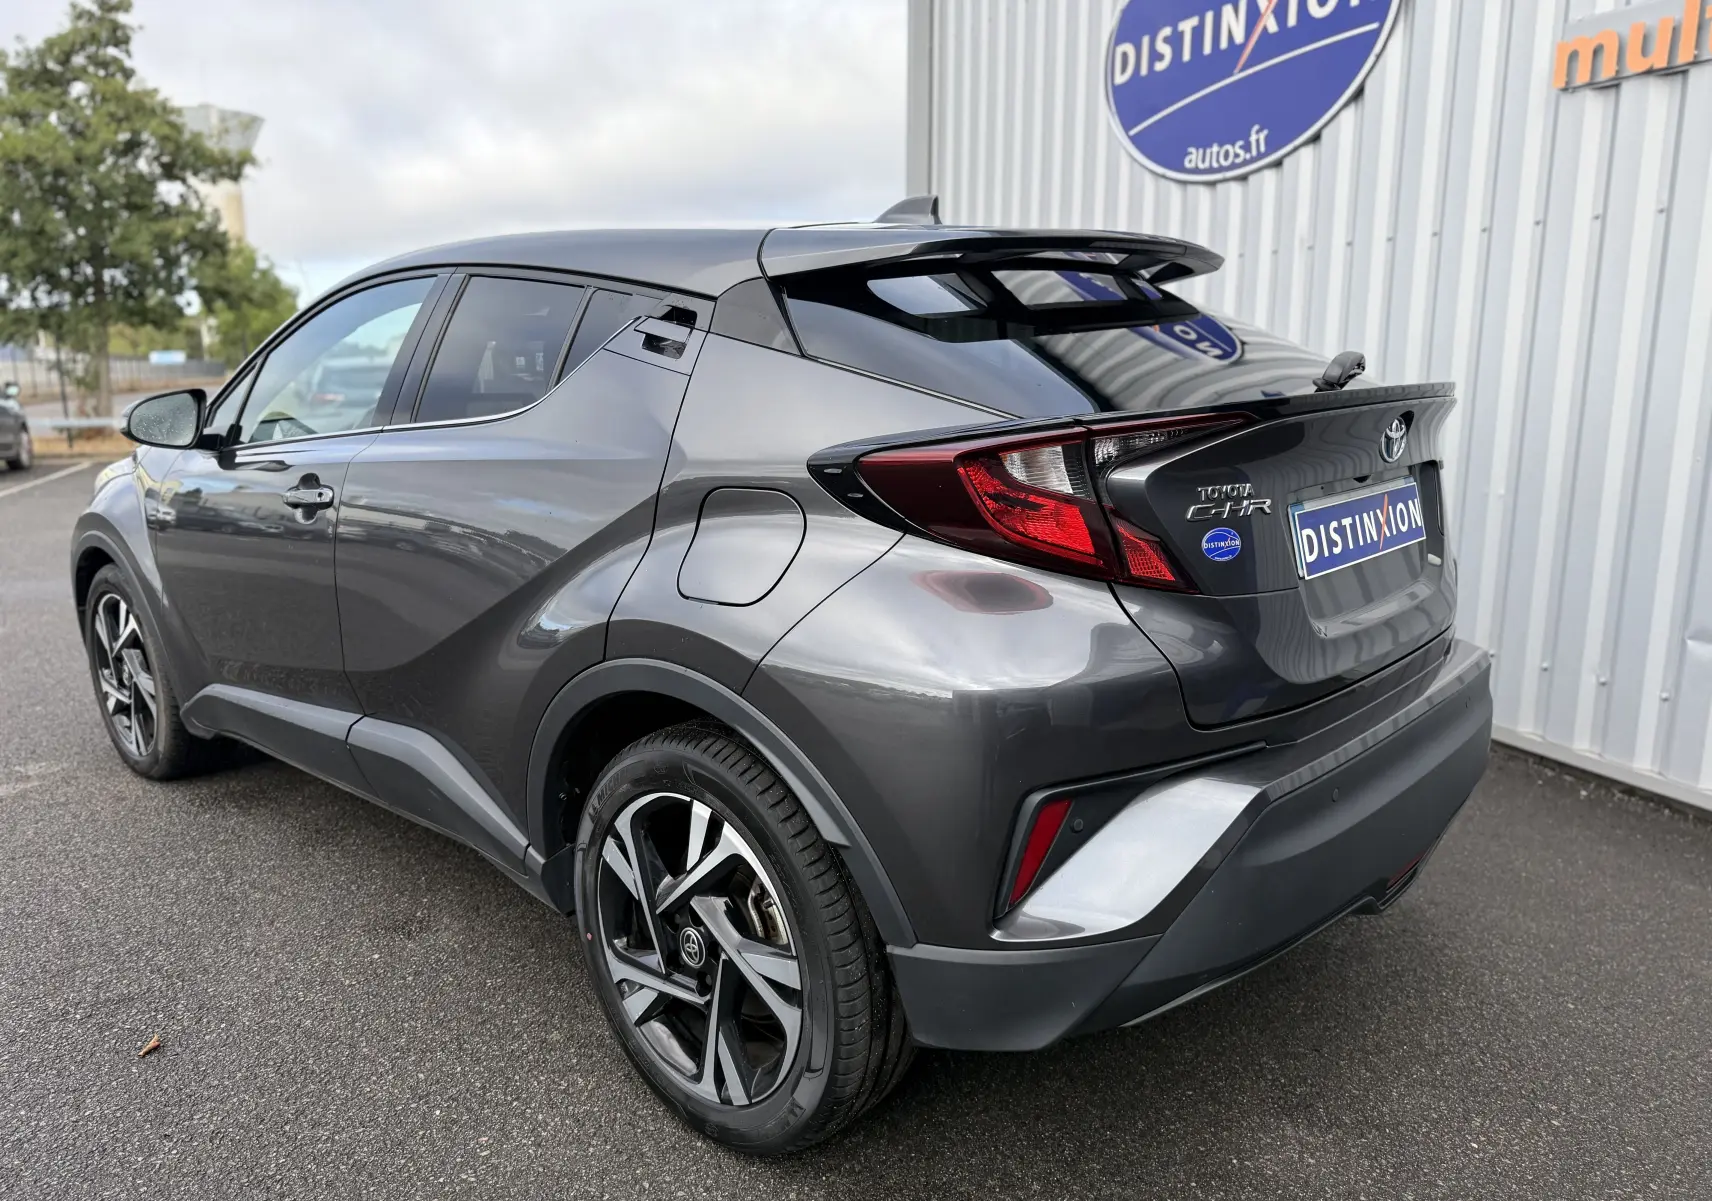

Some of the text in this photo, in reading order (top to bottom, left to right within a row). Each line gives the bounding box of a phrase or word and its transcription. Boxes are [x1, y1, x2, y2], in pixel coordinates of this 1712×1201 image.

[1113, 0, 1378, 86] DISTINXI
[1184, 125, 1269, 169] autos.fr
[1197, 483, 1254, 501] TOYOTA
[1186, 498, 1272, 522] C-HR
[1203, 536, 1240, 550] DISTINXION
[1301, 494, 1422, 563] DISTINXION
